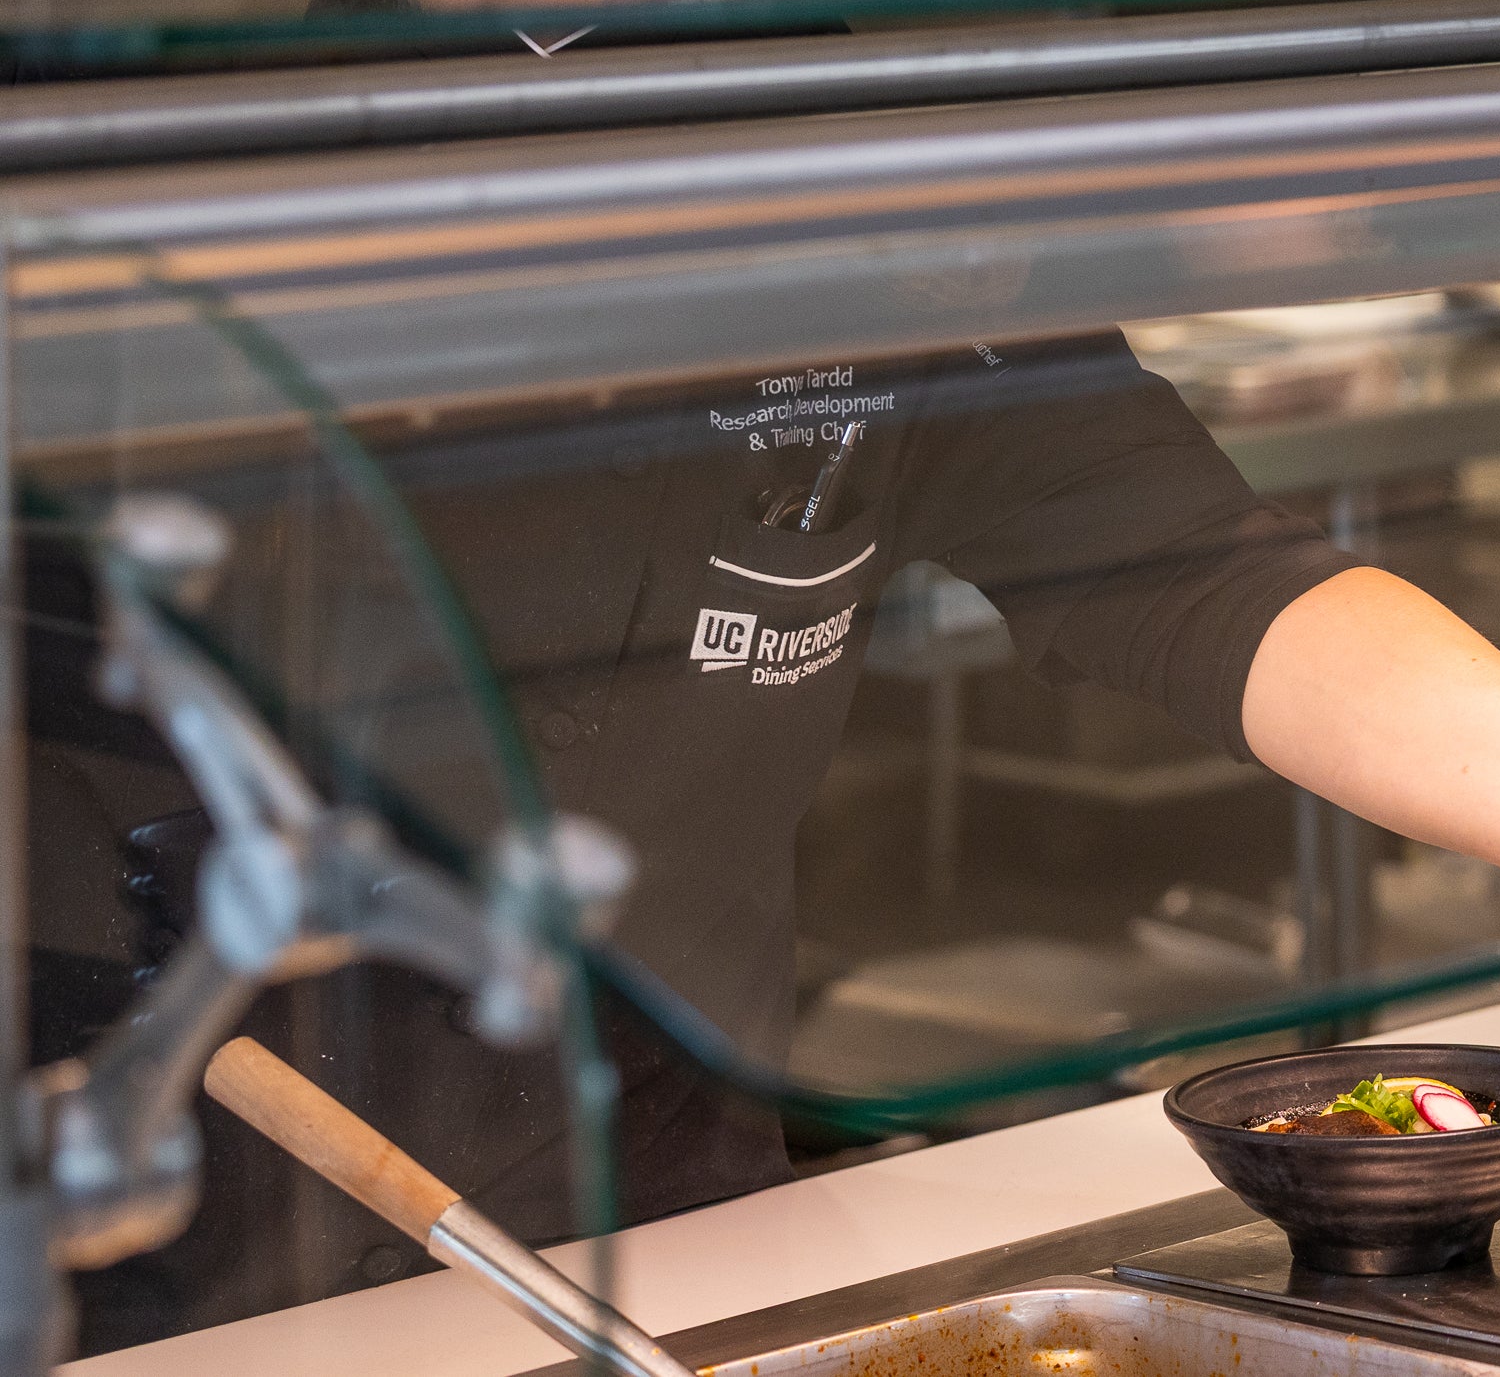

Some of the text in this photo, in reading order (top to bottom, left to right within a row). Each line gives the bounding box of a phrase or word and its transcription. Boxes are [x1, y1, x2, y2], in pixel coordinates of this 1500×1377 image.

[794, 392, 895, 418] Development
[749, 432, 768, 452] &
[820, 420, 867, 441] Chf
[703, 616, 745, 655] UC
[751, 644, 844, 686] Dining Services
